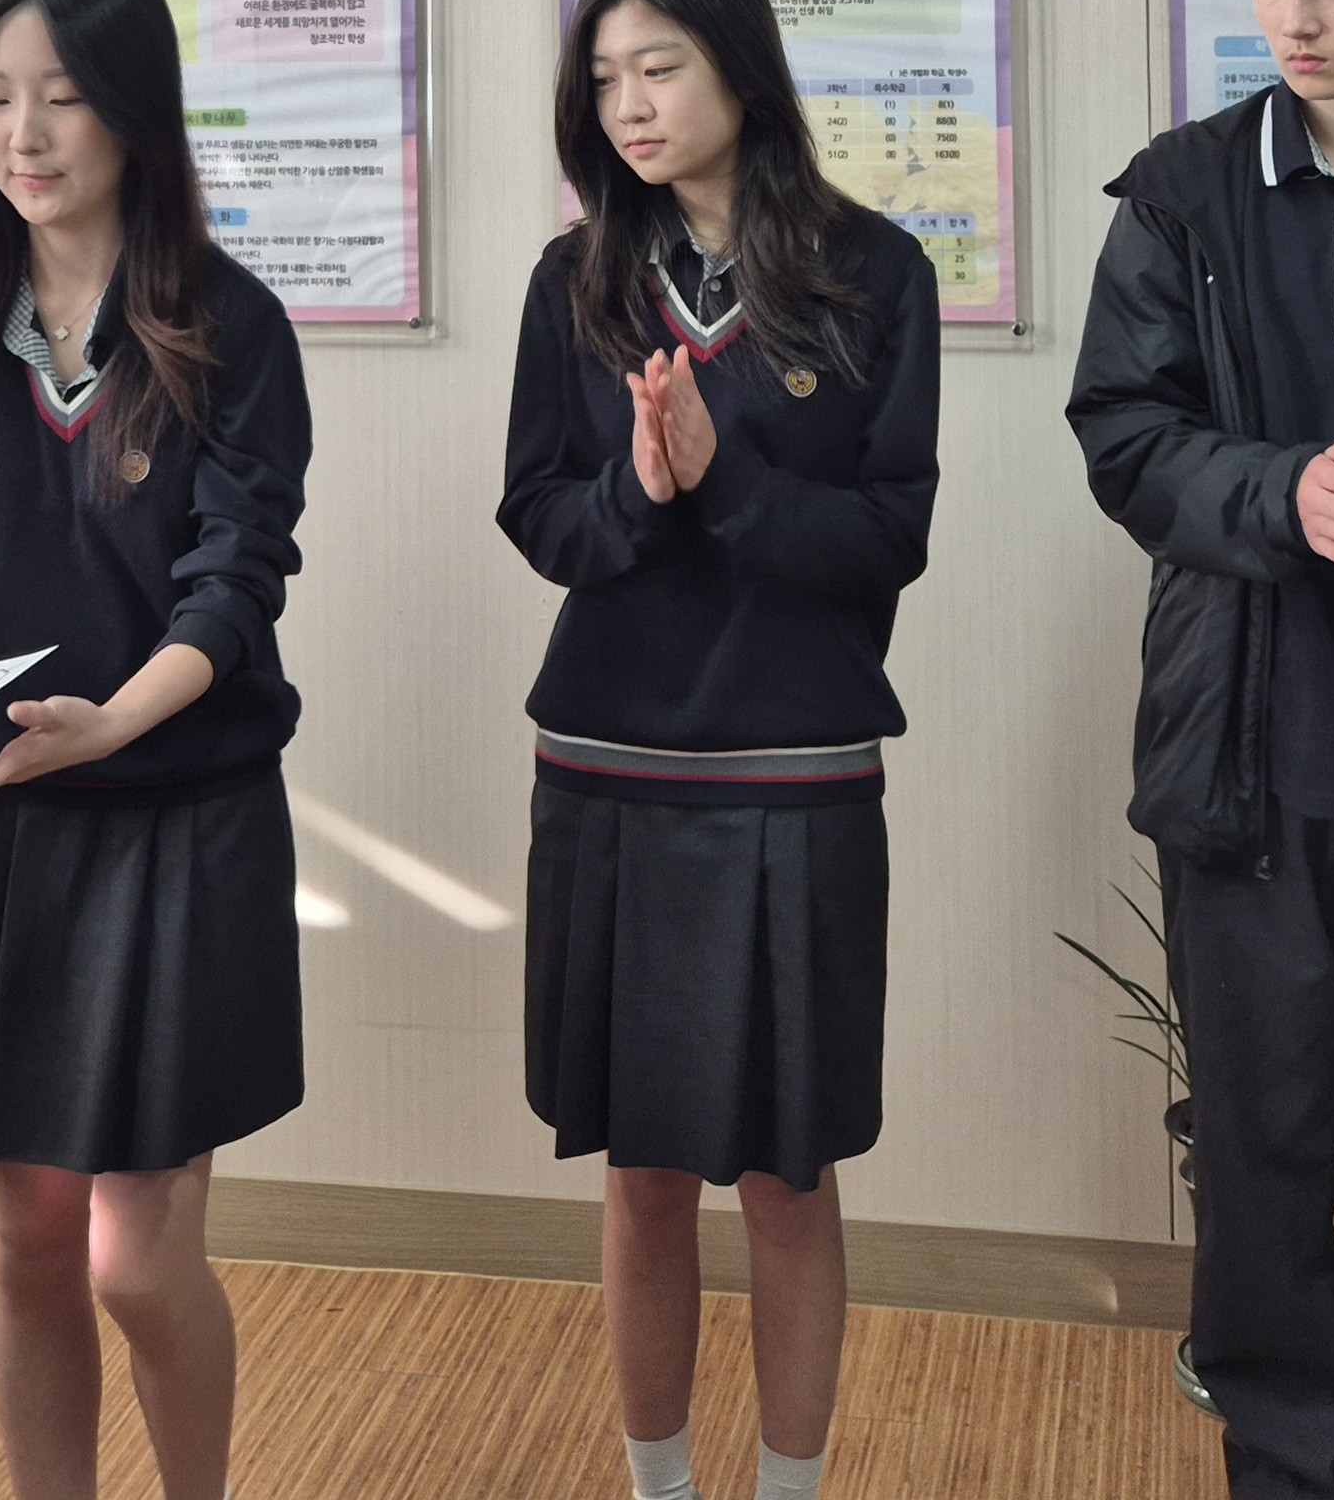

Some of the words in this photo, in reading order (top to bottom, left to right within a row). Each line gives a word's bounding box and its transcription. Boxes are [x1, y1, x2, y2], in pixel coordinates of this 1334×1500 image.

[780, 17, 798, 26] 50명
[826, 84, 847, 93] 3학년
[827, 117, 847, 126] 24(2)
[833, 134, 842, 142] 27
[828, 151, 848, 160] 51(2)
[955, 254, 965, 263] 25
[955, 271, 966, 280] 30
